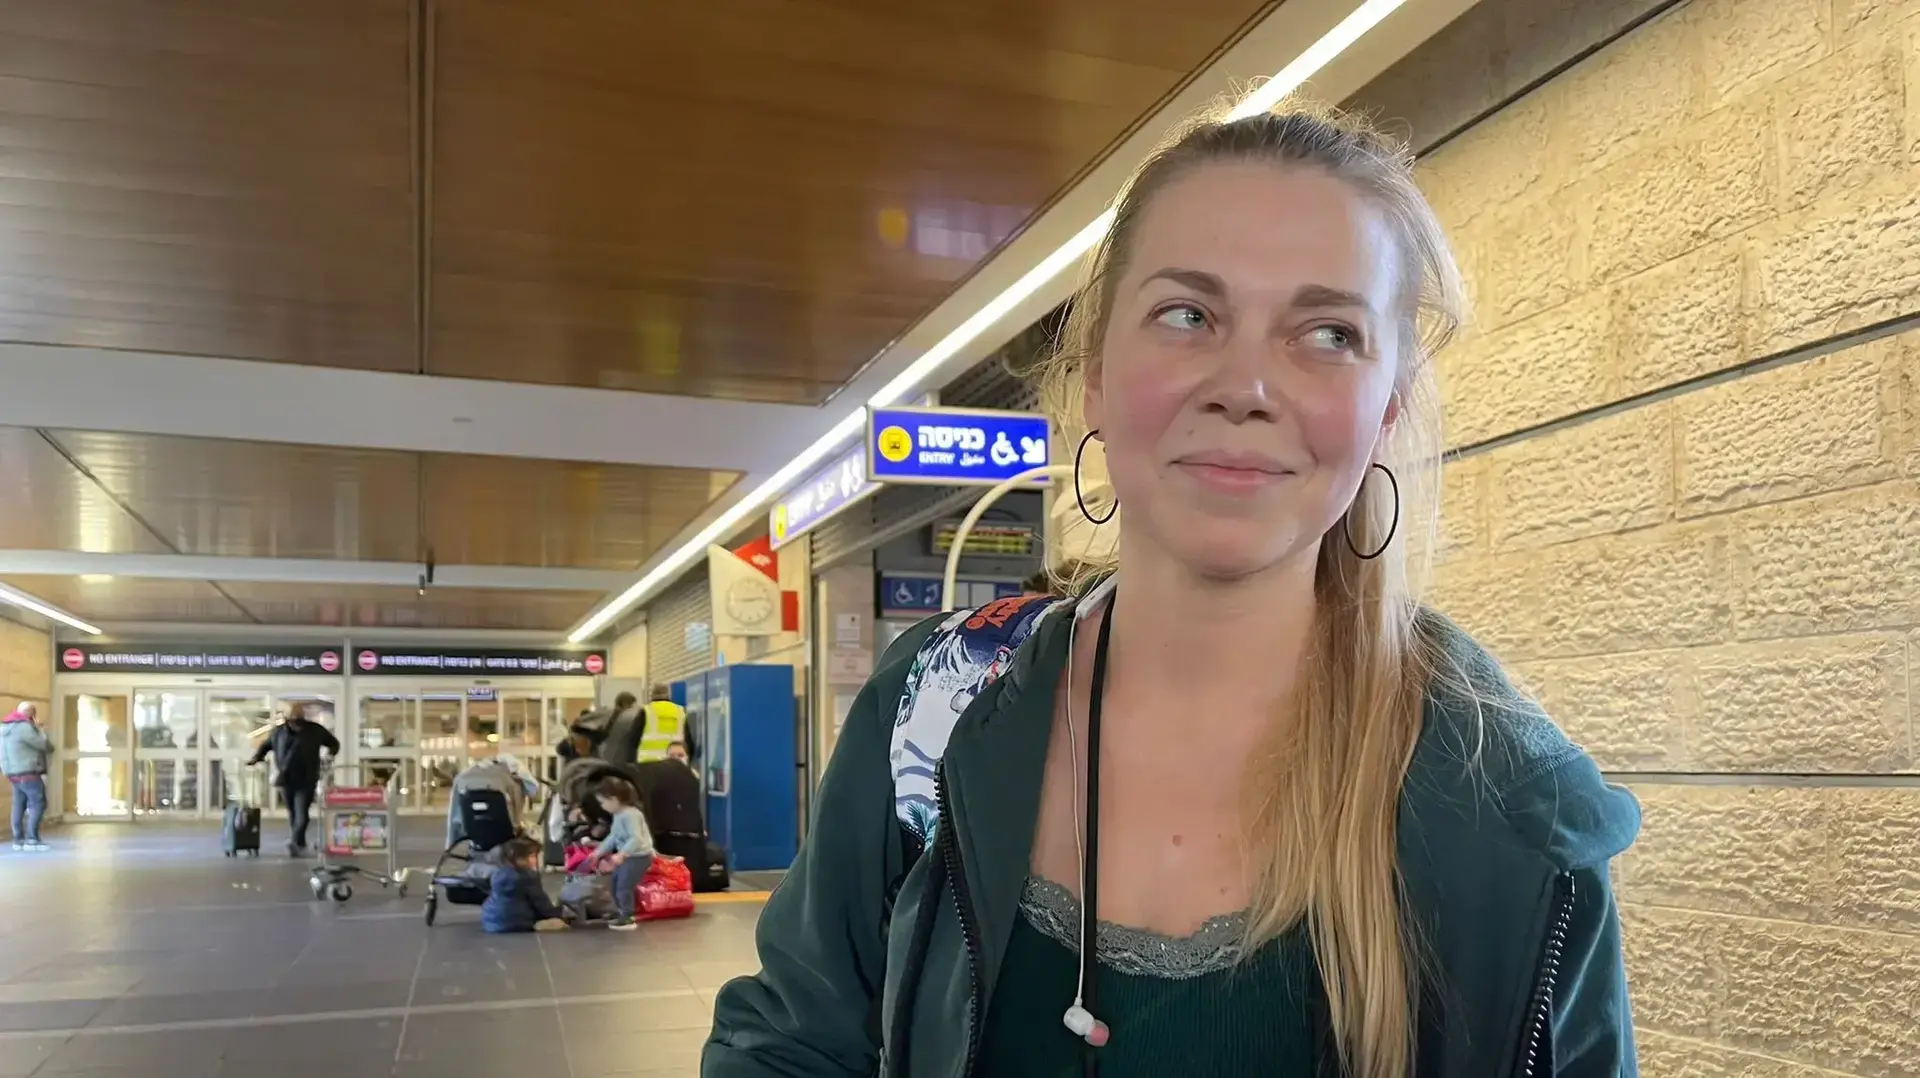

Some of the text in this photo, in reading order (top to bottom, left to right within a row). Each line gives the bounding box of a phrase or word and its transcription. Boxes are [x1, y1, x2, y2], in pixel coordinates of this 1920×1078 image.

[917, 425, 986, 450] כניסה
[918, 451, 956, 465] ENTRY
[89, 653, 154, 665] NO ENTRANCE
[381, 655, 440, 667] NO ENTRANCE
